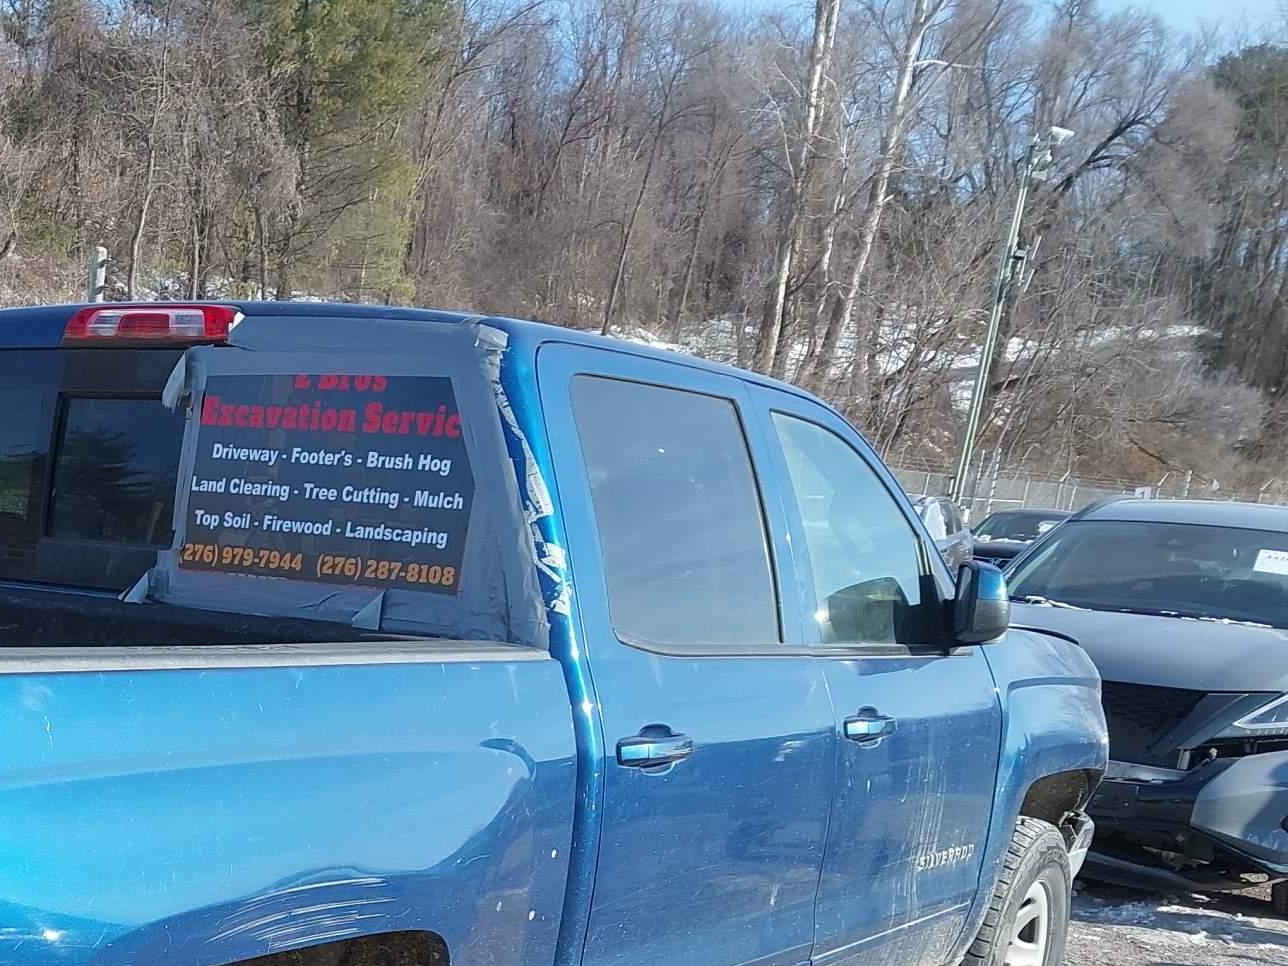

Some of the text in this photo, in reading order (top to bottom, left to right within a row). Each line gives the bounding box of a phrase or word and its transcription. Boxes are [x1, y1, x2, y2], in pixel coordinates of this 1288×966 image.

[200, 396, 462, 438] Excavation Servic
[212, 443, 279, 466] Driveway
[292, 448, 353, 467] Footer's
[366, 451, 413, 470] Brush
[418, 454, 451, 476] Hog
[191, 476, 225, 493] Land
[229, 478, 290, 501] Clearing
[303, 483, 338, 501] Tree
[342, 486, 400, 508] Cutting
[413, 490, 464, 510] Mulch
[194, 509, 220, 530] Top
[223, 511, 251, 529] Soil
[263, 515, 332, 536] Firewood
[345, 522, 448, 549] Landscaping
[222, 546, 303, 571] 979-7944
[316, 554, 362, 581] (276)
[364, 559, 455, 586] 287-8108
[918, 844, 975, 871] SILVERADO
